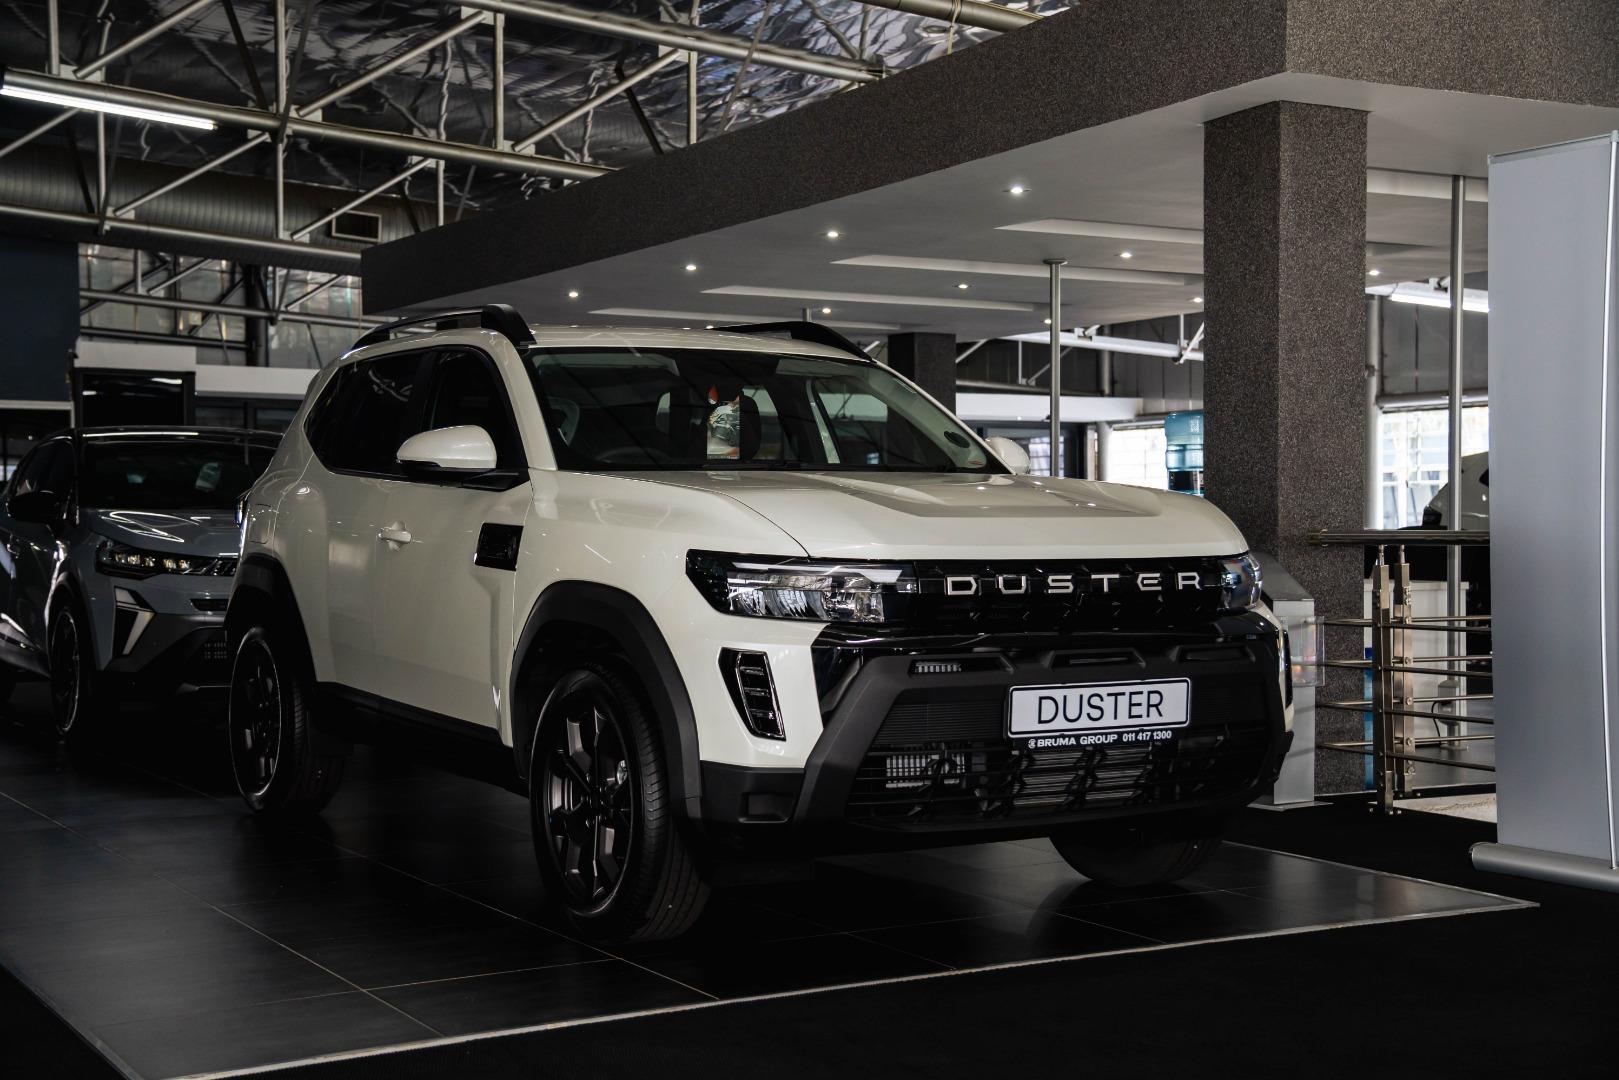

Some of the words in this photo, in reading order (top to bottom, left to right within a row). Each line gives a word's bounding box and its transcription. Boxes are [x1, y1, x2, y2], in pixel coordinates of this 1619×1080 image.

[946, 572, 1202, 596] DUSTER
[1037, 689, 1164, 725] DUSTER
[1036, 737, 1077, 748] BRUMA
[1079, 734, 1118, 745] GROUP
[1122, 733, 1136, 742] 011
[1136, 731, 1151, 741] 417
[1152, 730, 1172, 740] 1300
